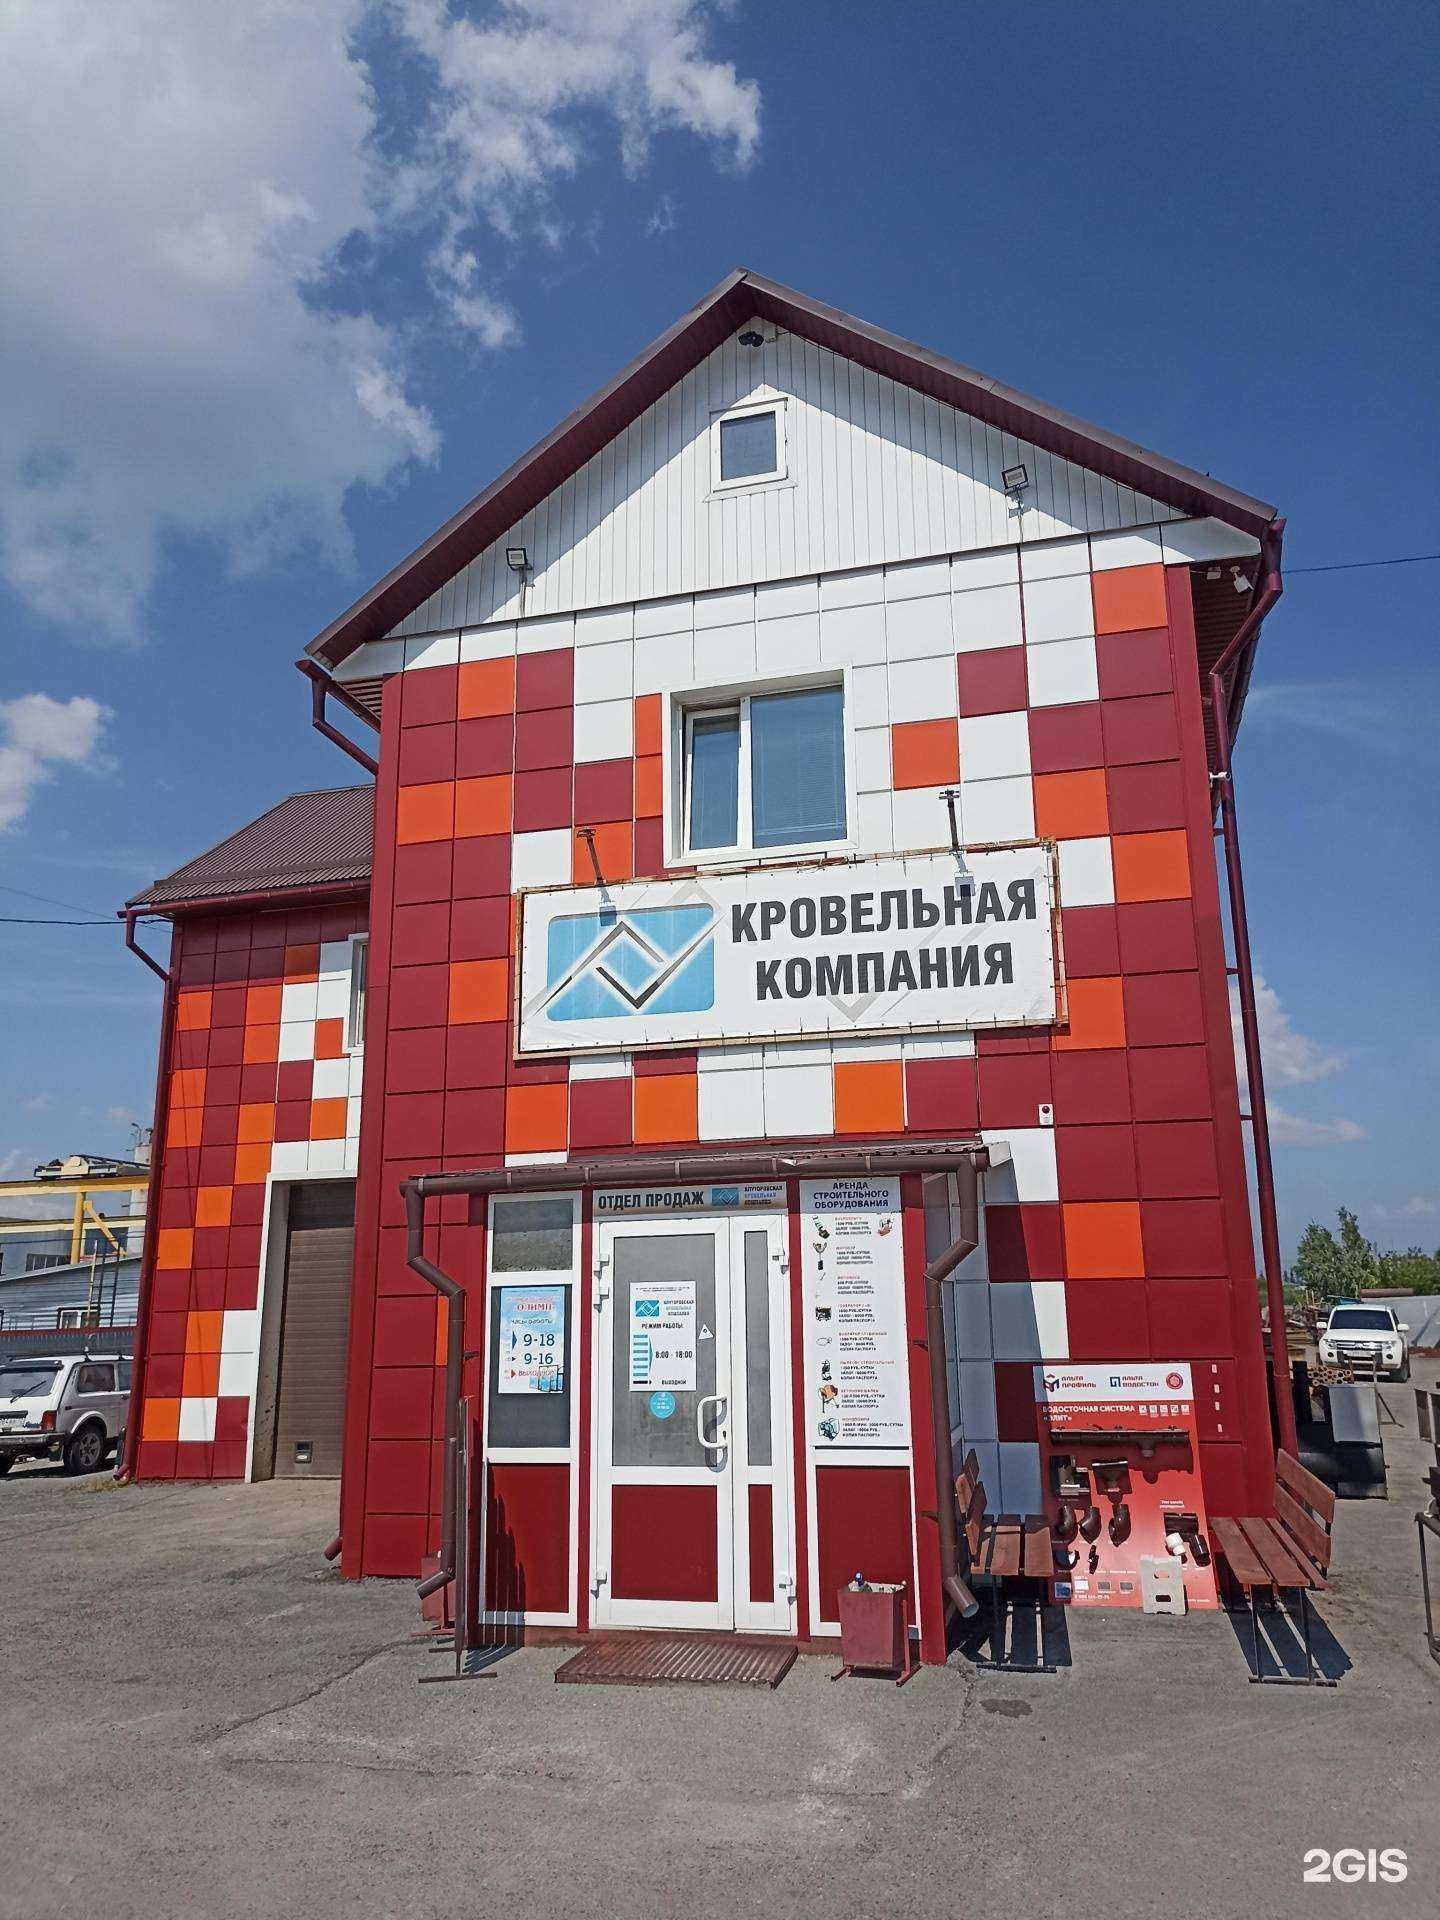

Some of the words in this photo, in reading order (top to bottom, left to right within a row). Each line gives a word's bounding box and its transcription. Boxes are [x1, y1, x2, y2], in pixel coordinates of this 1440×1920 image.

[732, 878, 1037, 943] КРОВЕЛЬНАЯ
[755, 942, 1014, 1002] КОМПАНИЯ
[833, 1182, 868, 1190] АРЕНДА
[813, 1190, 889, 1199] СТРОИТЕЛЬНОГО
[599, 1194, 641, 1211] ОТДЕЛ
[645, 1191, 704, 1209] ПРОДАЖ
[814, 1200, 889, 1209] ОБОРУДОВАНИЯ
[523, 1333, 555, 1347] 9-18
[524, 1353, 553, 1365] 9-16
[655, 1351, 669, 1359] 8:00
[1042, 1405, 1100, 1413] ВОДОСТОЧНАЯ
[1100, 1405, 1136, 1413] СИСТЕМА
